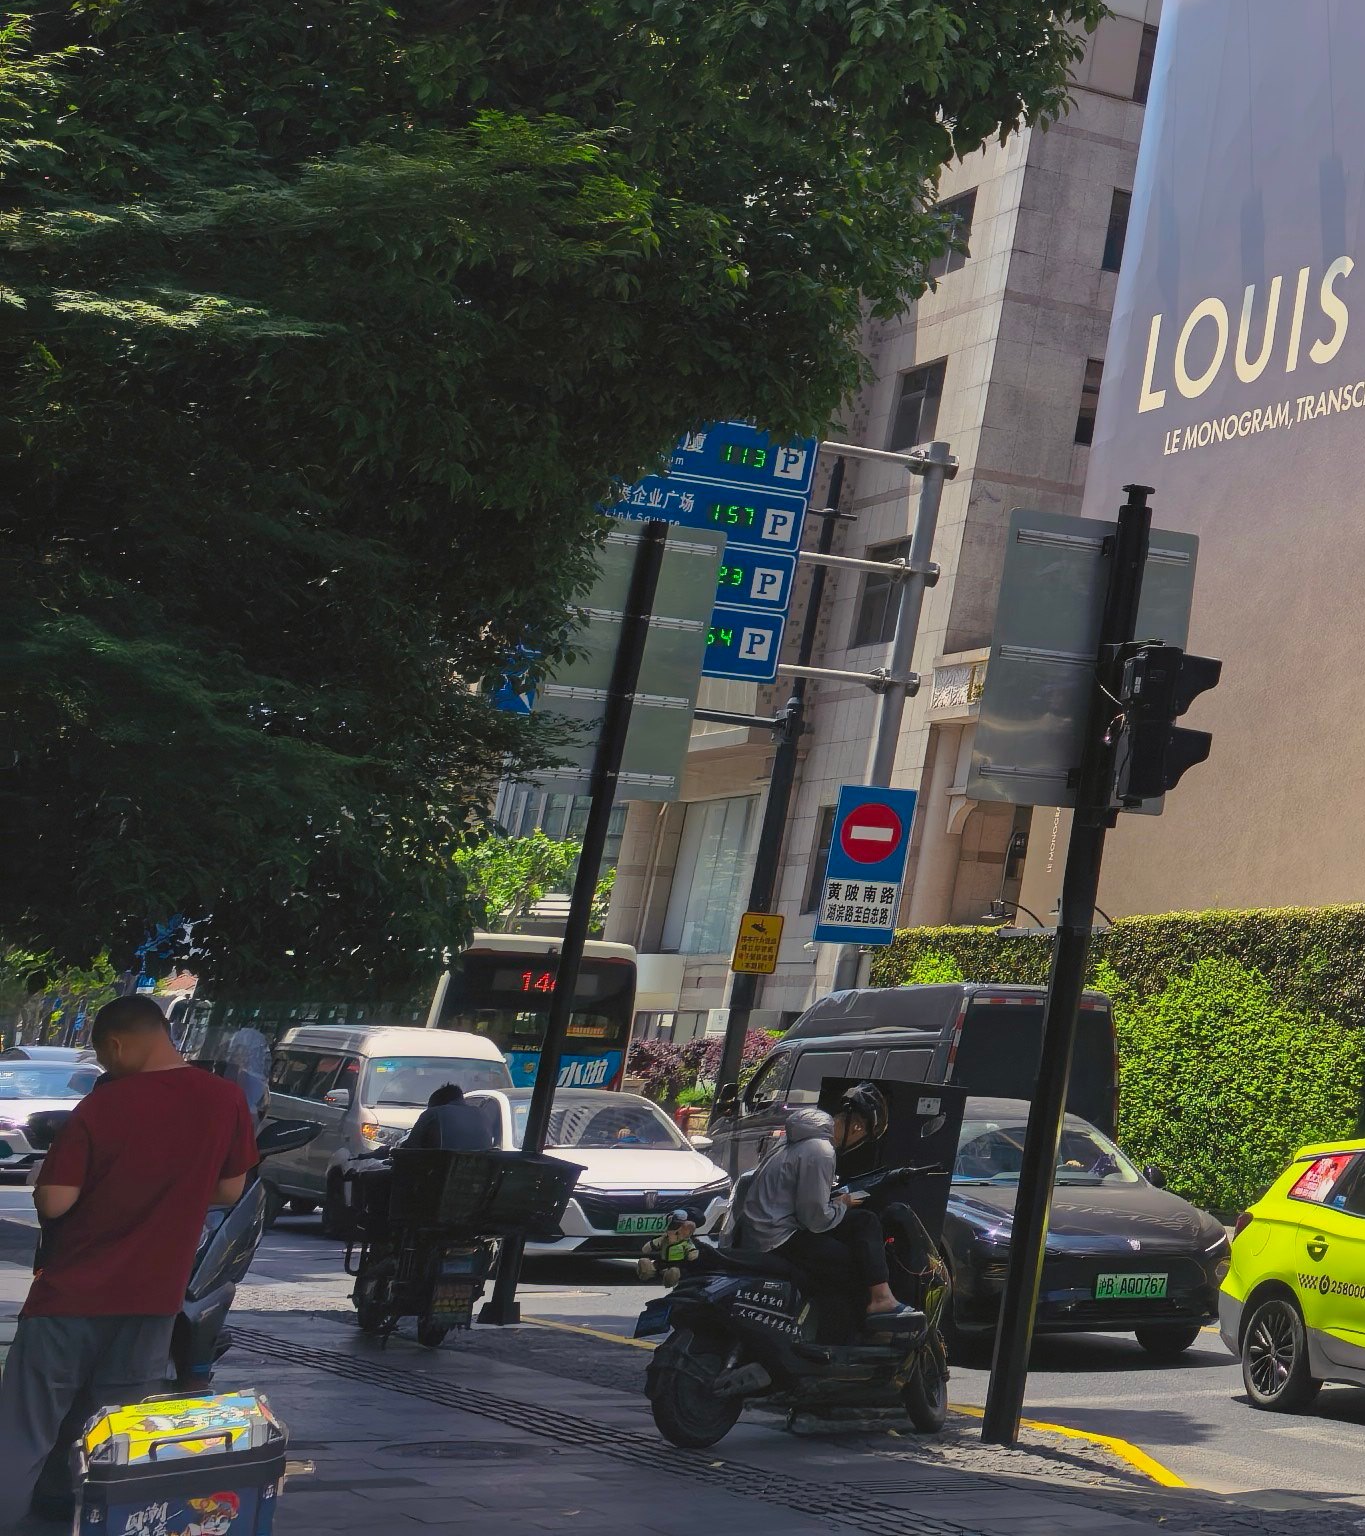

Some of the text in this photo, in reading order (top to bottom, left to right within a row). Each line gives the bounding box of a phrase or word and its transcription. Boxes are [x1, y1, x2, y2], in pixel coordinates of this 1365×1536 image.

[1138, 256, 1354, 413] LOUIS
[1164, 429, 1181, 455] LE
[1182, 401, 1293, 450] MONOGRAM,
[726, 445, 767, 468] 113
[714, 505, 756, 525] 157
[827, 882, 895, 904] 黄陂南路
